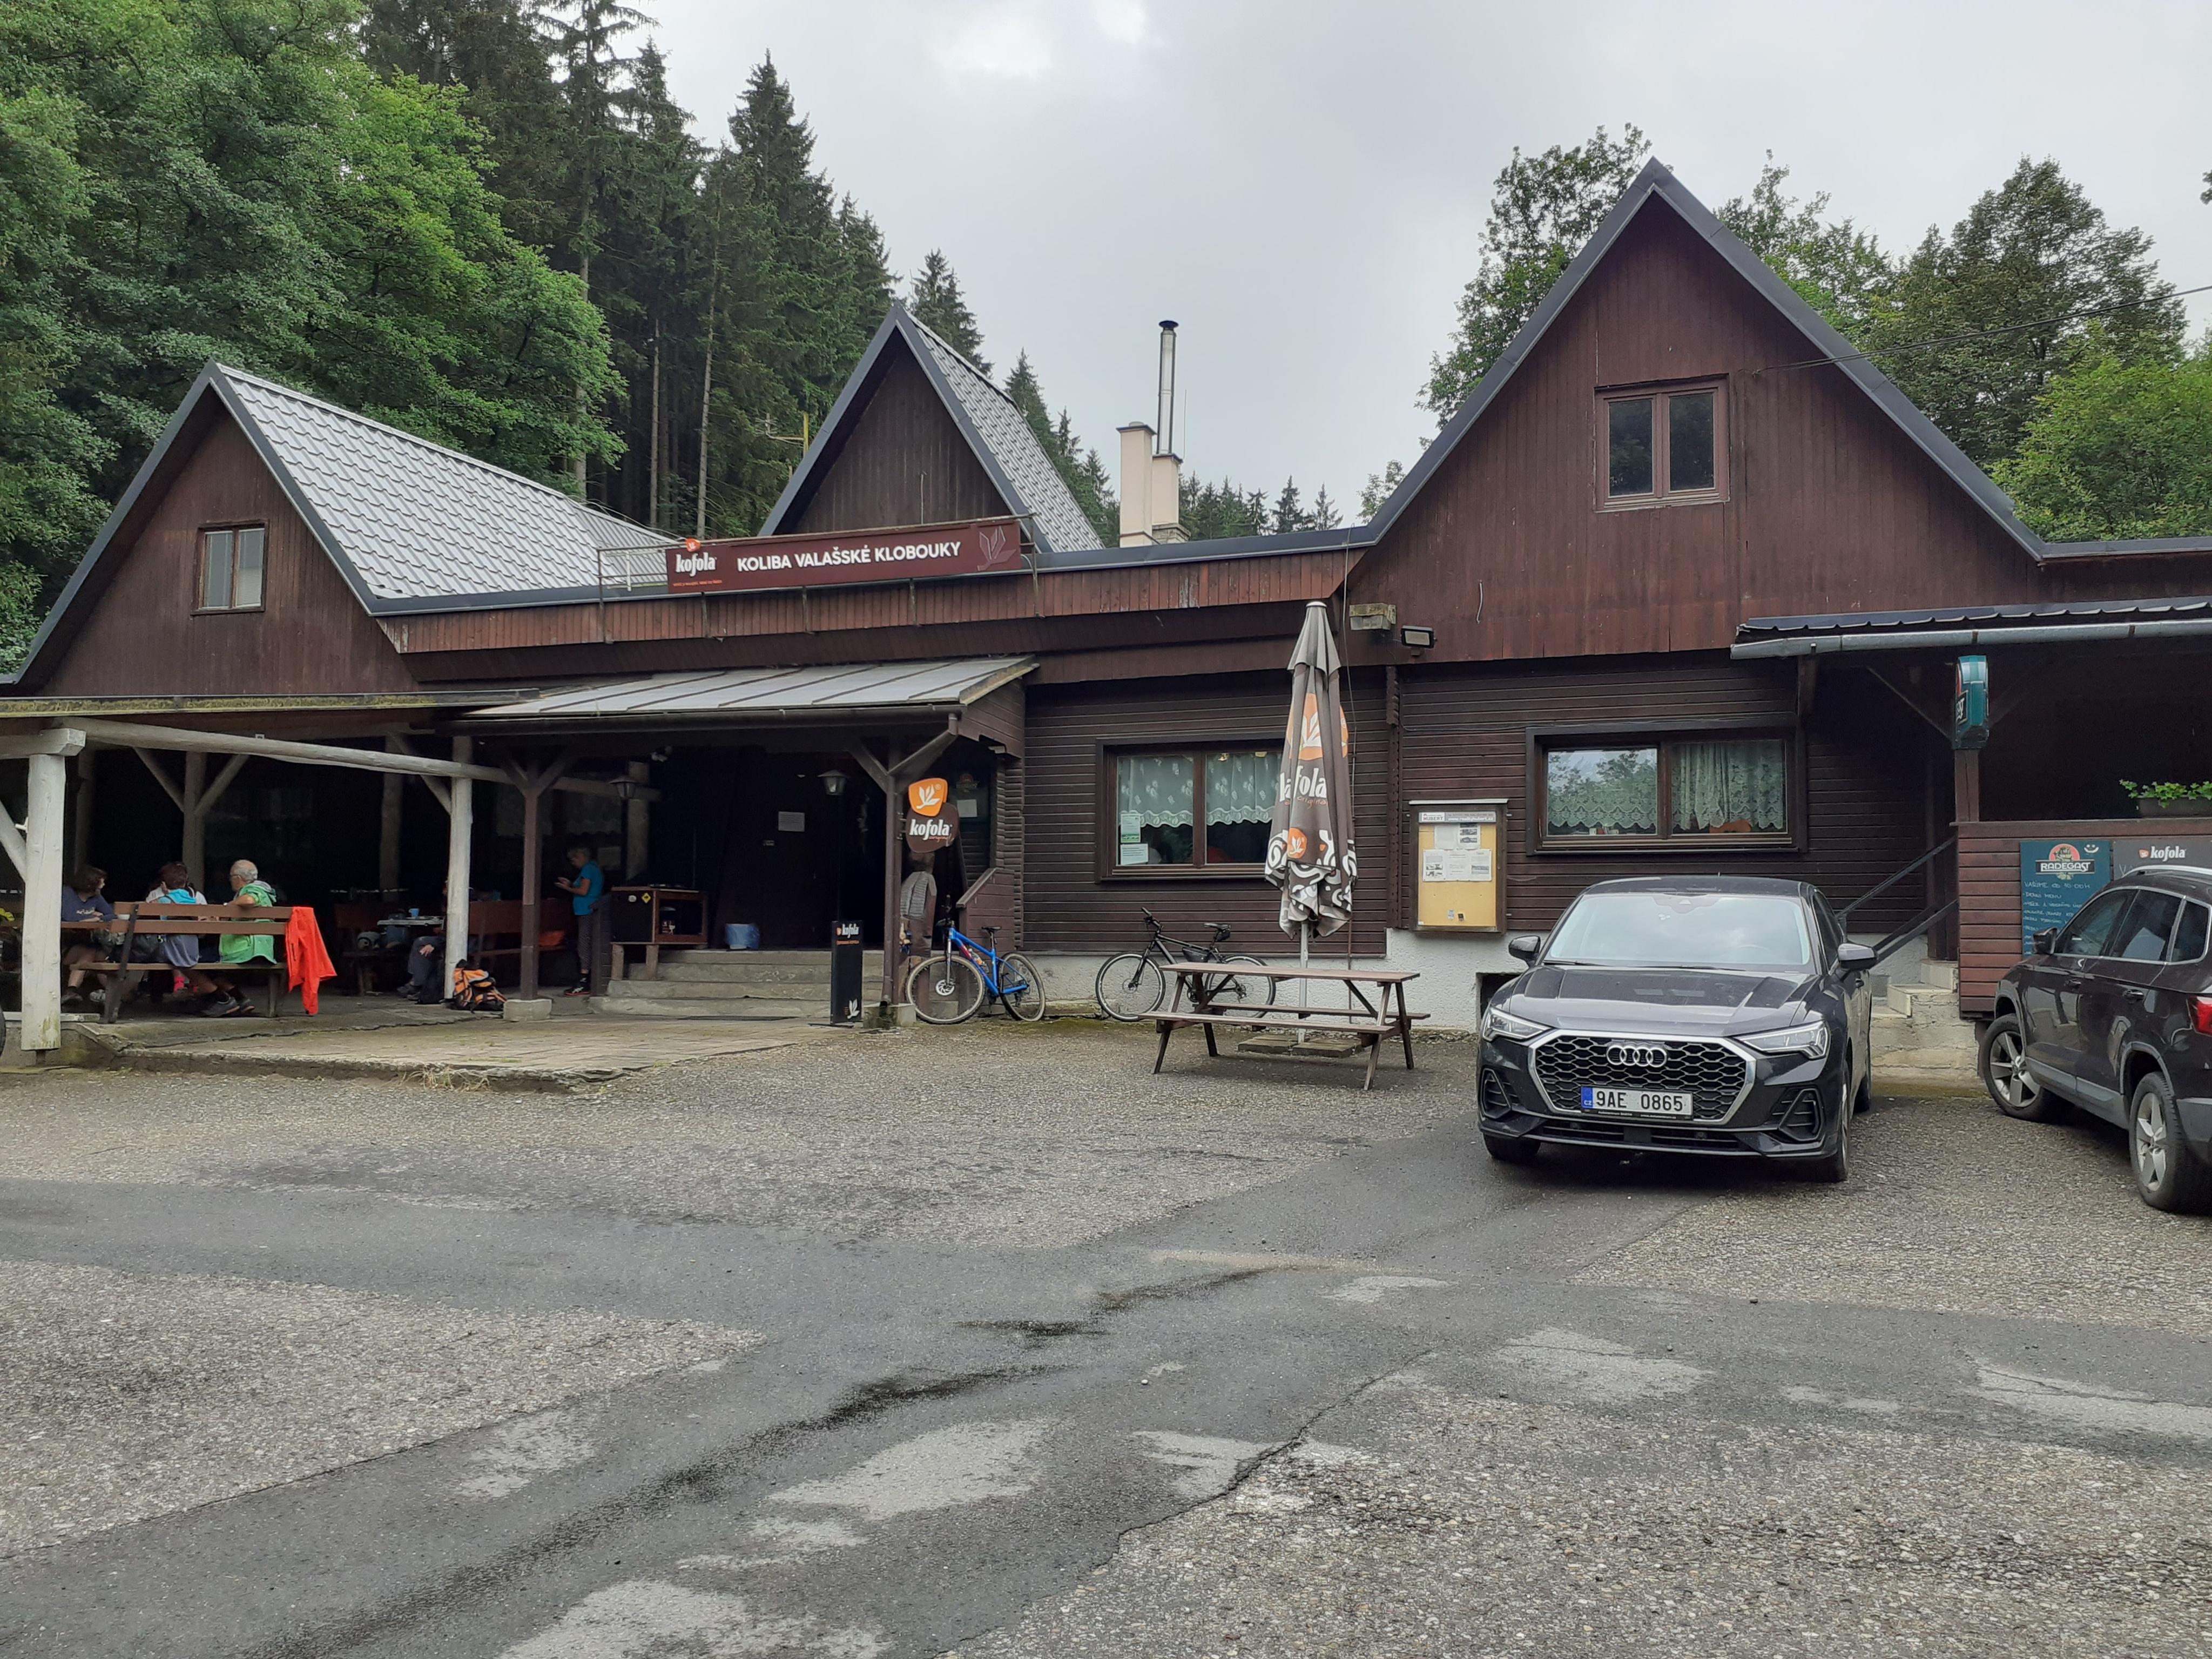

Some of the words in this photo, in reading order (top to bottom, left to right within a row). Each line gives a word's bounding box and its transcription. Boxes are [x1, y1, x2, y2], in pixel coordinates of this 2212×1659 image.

[676, 552, 716, 577] kofola
[737, 555, 792, 572] KOLIBA
[794, 545, 872, 568] VALAŠSKÉ
[874, 541, 962, 562] KLOBOUKY
[909, 819, 950, 840] kofola
[2150, 846, 2186, 862] kofola
[2040, 862, 2091, 872] RADEGAST
[842, 923, 859, 939] kofola
[1596, 1090, 1627, 1108] 9AE
[1641, 1094, 1683, 1111] 0865
